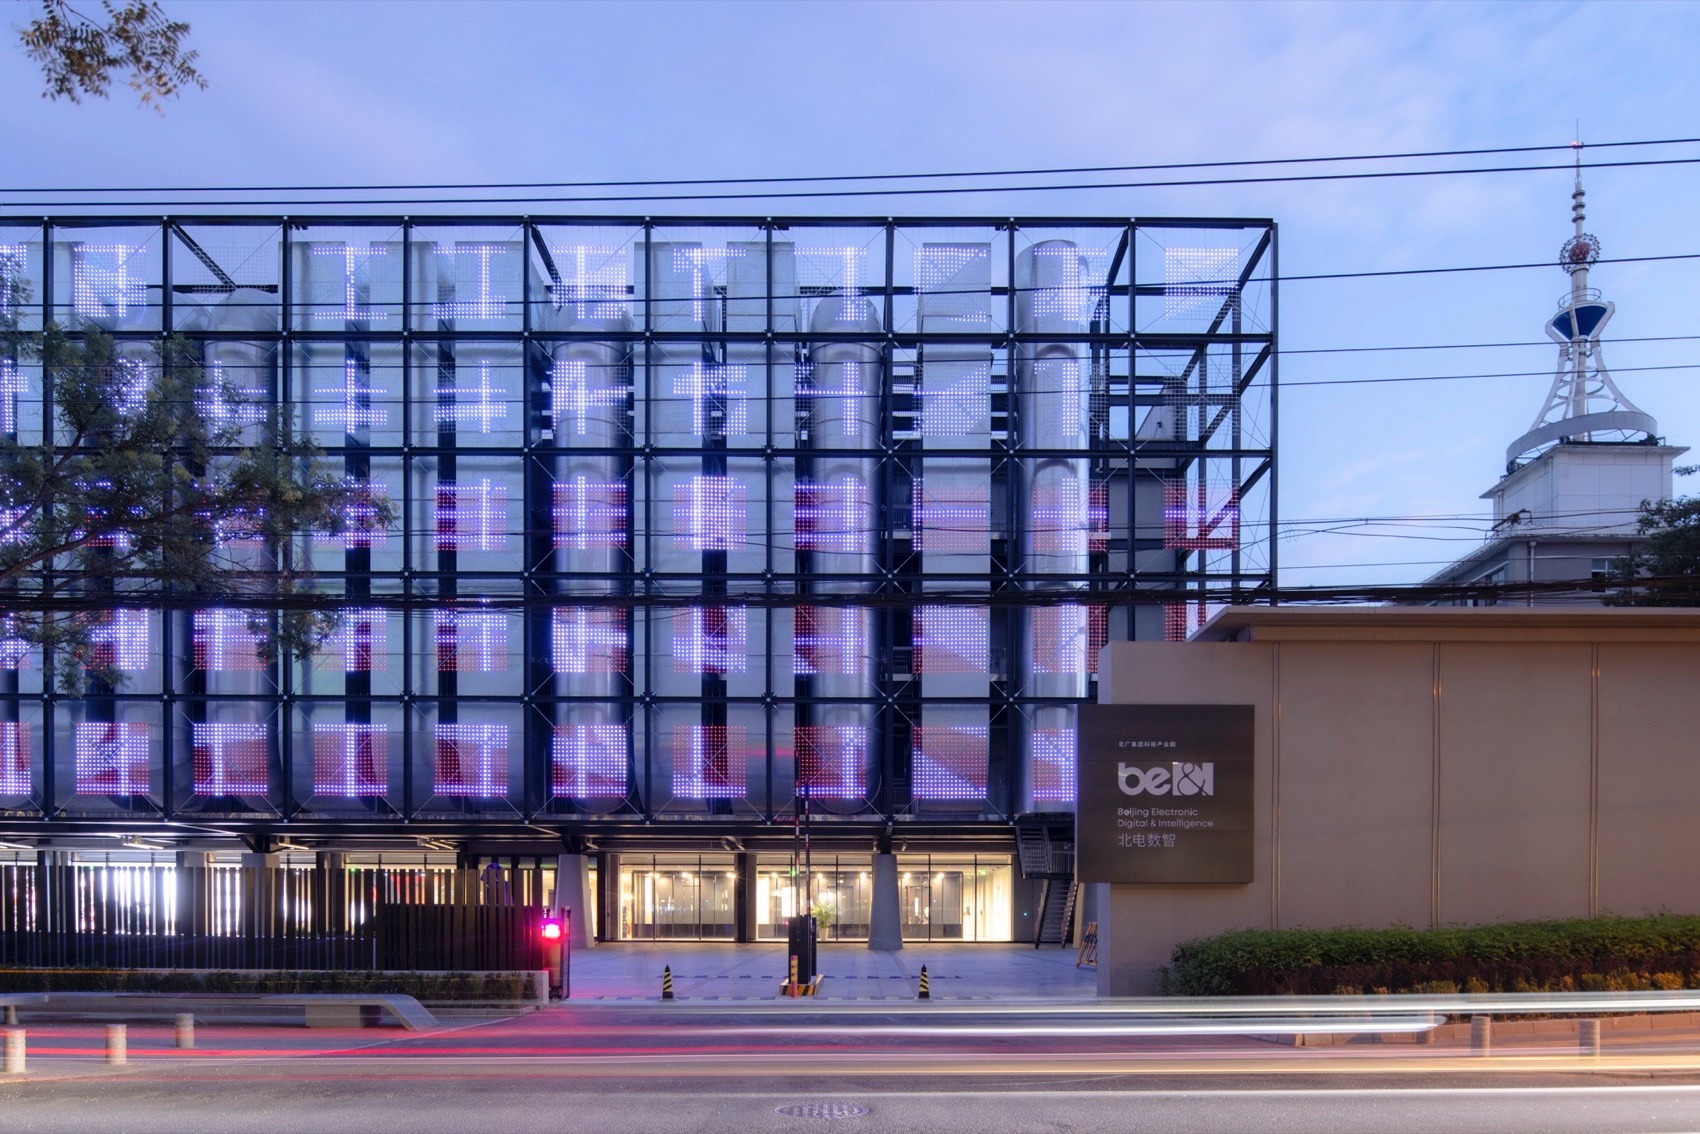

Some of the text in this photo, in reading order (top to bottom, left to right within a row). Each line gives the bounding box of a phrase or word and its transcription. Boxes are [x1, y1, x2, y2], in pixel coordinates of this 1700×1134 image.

[1117, 807, 1198, 817] Beijing Electronic
[1117, 819, 1214, 829] Digital & Intelligence
[1117, 833, 1176, 848] 北电数智
